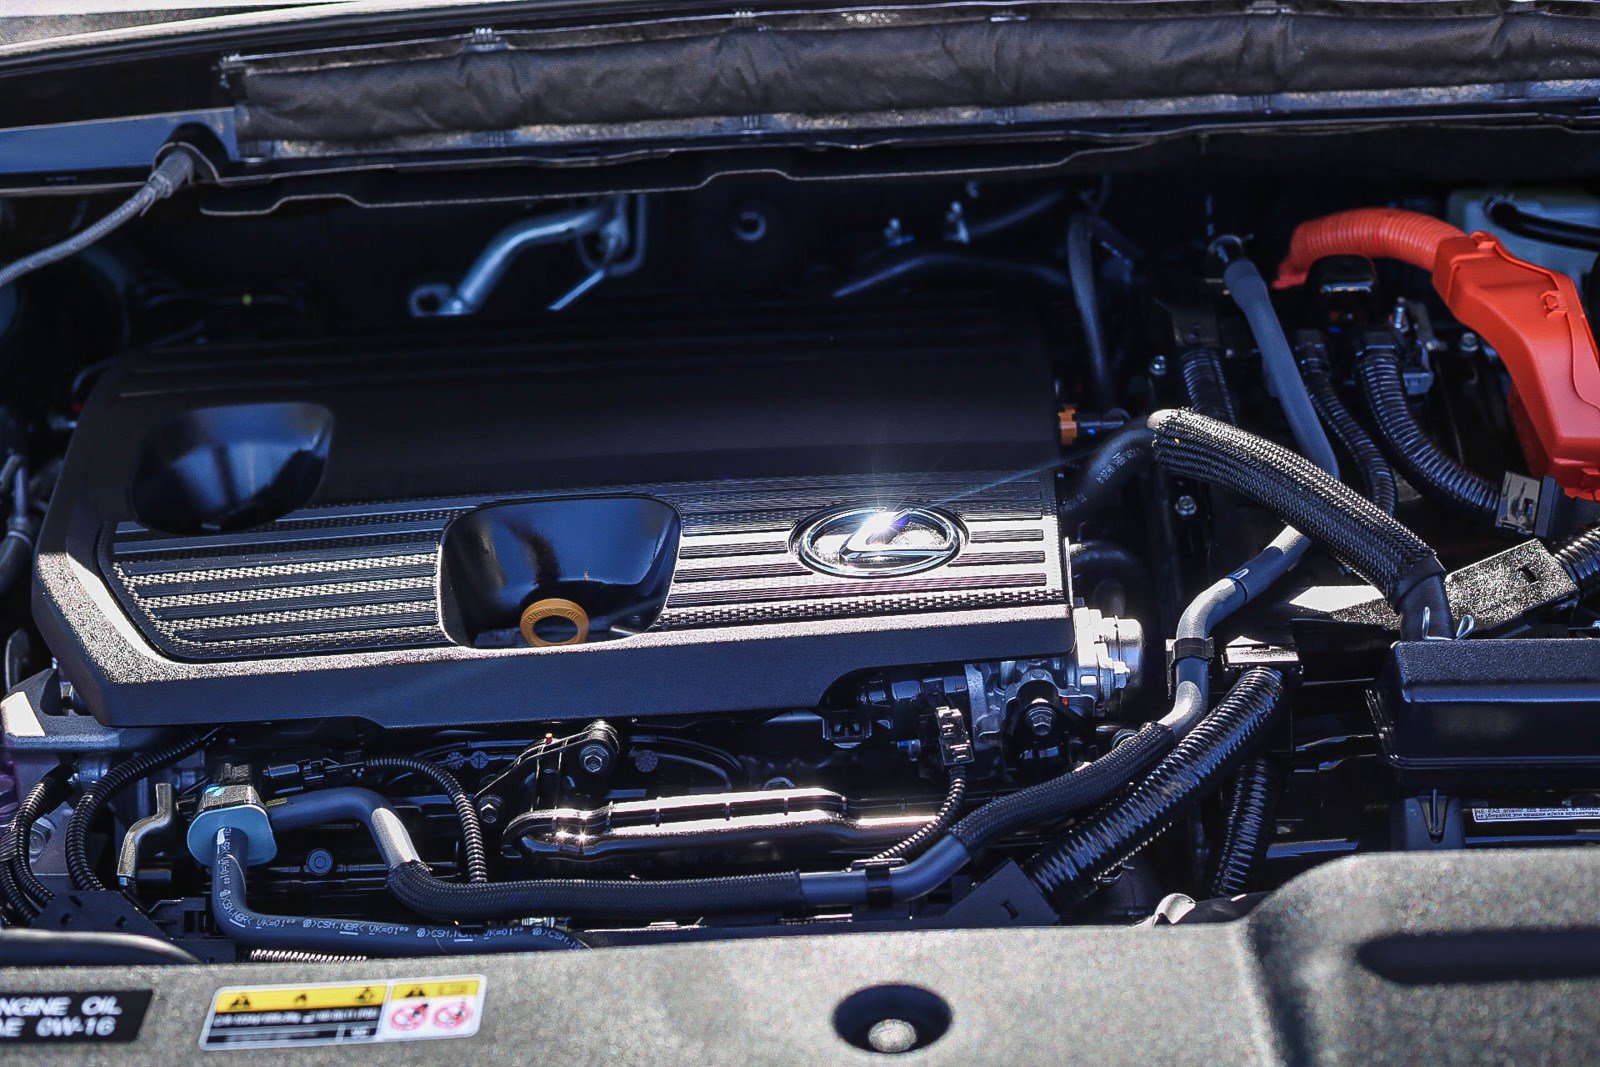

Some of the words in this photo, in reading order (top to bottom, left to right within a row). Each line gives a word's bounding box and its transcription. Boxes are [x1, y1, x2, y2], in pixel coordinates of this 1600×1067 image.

[526, 608, 558, 625] ENGINE
[566, 610, 580, 620] OIL
[81, 995, 122, 1015] OIL
[36, 1015, 116, 1036] 0W-16
